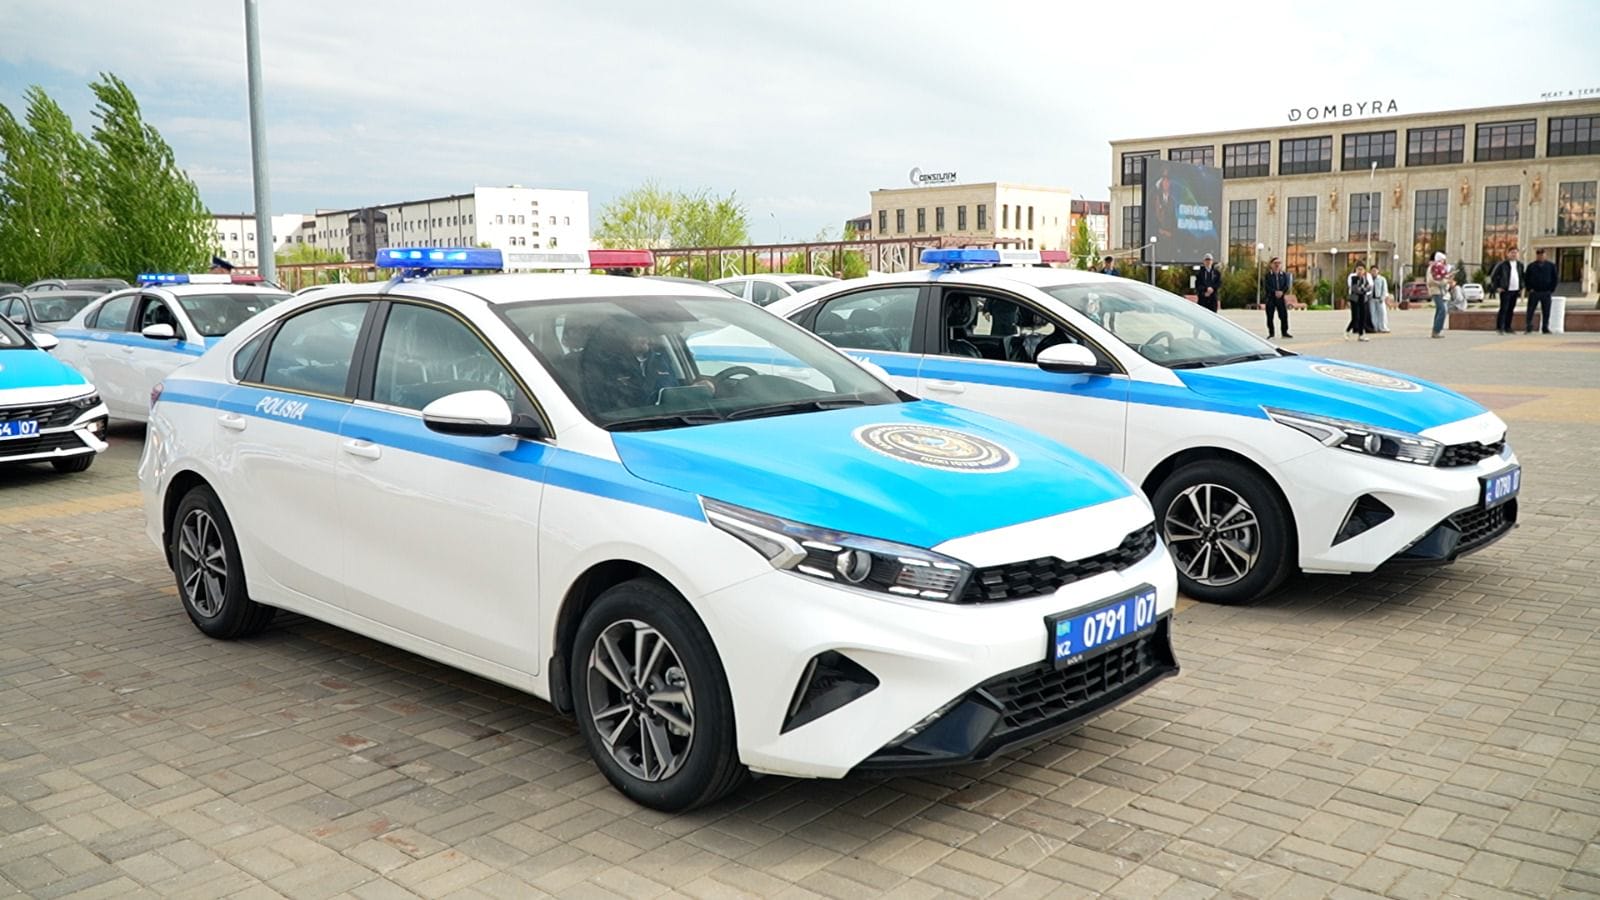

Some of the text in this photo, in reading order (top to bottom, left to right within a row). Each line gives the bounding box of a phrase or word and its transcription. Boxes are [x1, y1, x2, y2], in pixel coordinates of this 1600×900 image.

[1288, 99, 1398, 122] DOMBYRA
[255, 396, 308, 420] POLISIA
[21, 420, 38, 434] 07
[1083, 593, 1156, 648] 0791 07
[1056, 641, 1072, 659] KZ
